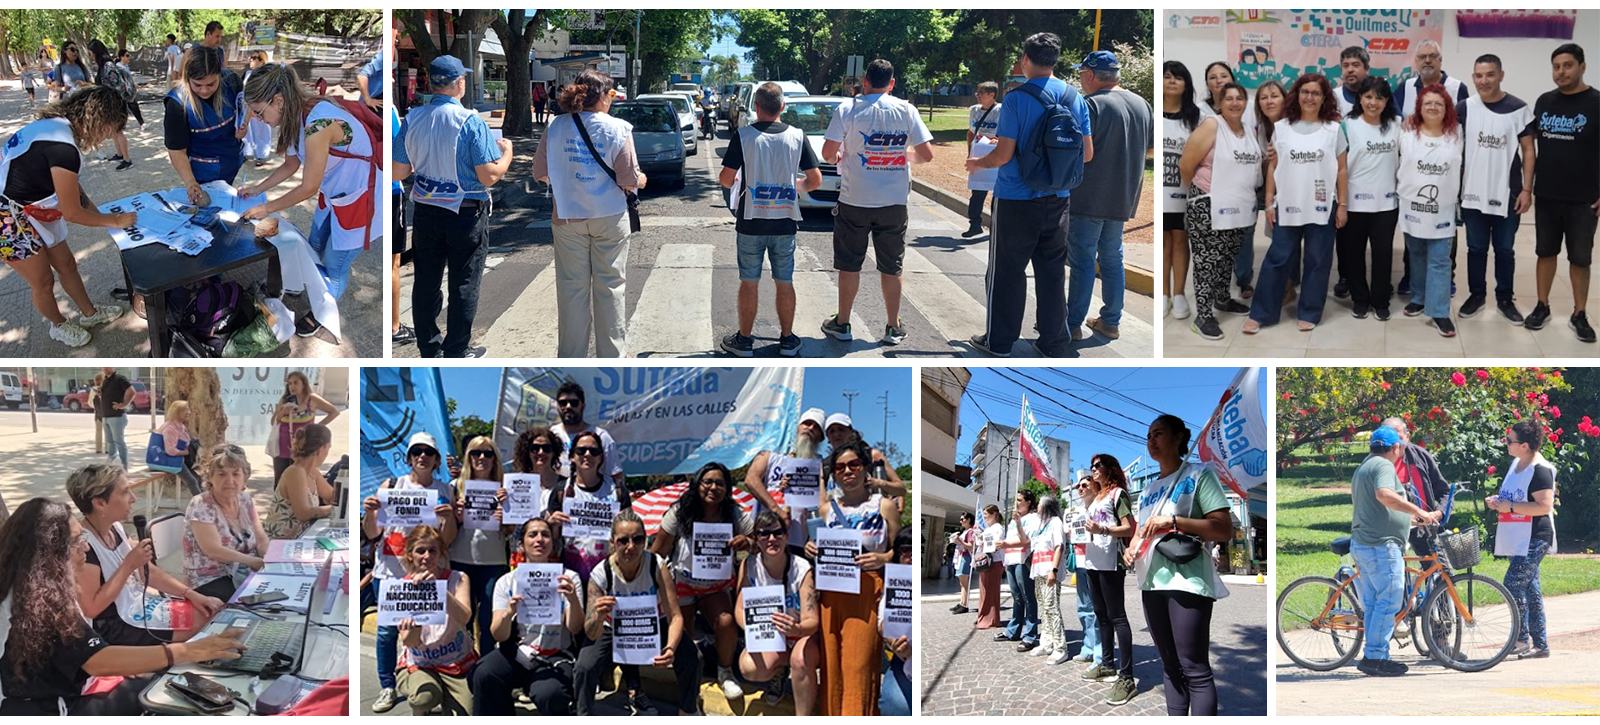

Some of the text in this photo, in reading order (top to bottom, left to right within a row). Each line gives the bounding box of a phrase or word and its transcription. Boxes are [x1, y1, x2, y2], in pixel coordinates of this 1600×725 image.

[1191, 16, 1220, 24] CTA
[1346, 16, 1398, 33] Quilmes
[1300, 34, 1343, 47] CTERA
[1367, 38, 1410, 50] CTA
[1540, 111, 1575, 127] Suteba
[867, 133, 908, 146] CTA
[1478, 131, 1500, 145] Suteba
[1366, 140, 1391, 152] Suteba
[866, 155, 906, 165] CTA
[1290, 149, 1316, 160] Suteba
[1417, 159, 1442, 172] Suteba
[415, 174, 459, 193] CTA
[755, 187, 796, 201] CTA
[655, 406, 671, 419] EN
[673, 404, 693, 416] LAS
[696, 400, 737, 415] CALLES
[388, 497, 428, 506] PAGO DEL
[584, 501, 612, 511] FONDOS
[396, 507, 420, 515] FONID
[570, 509, 613, 519] NACIONALES
[403, 582, 436, 592] FONDOS
[386, 592, 438, 601] NACIONALES
[396, 602, 444, 611] EDUCACIÓN
